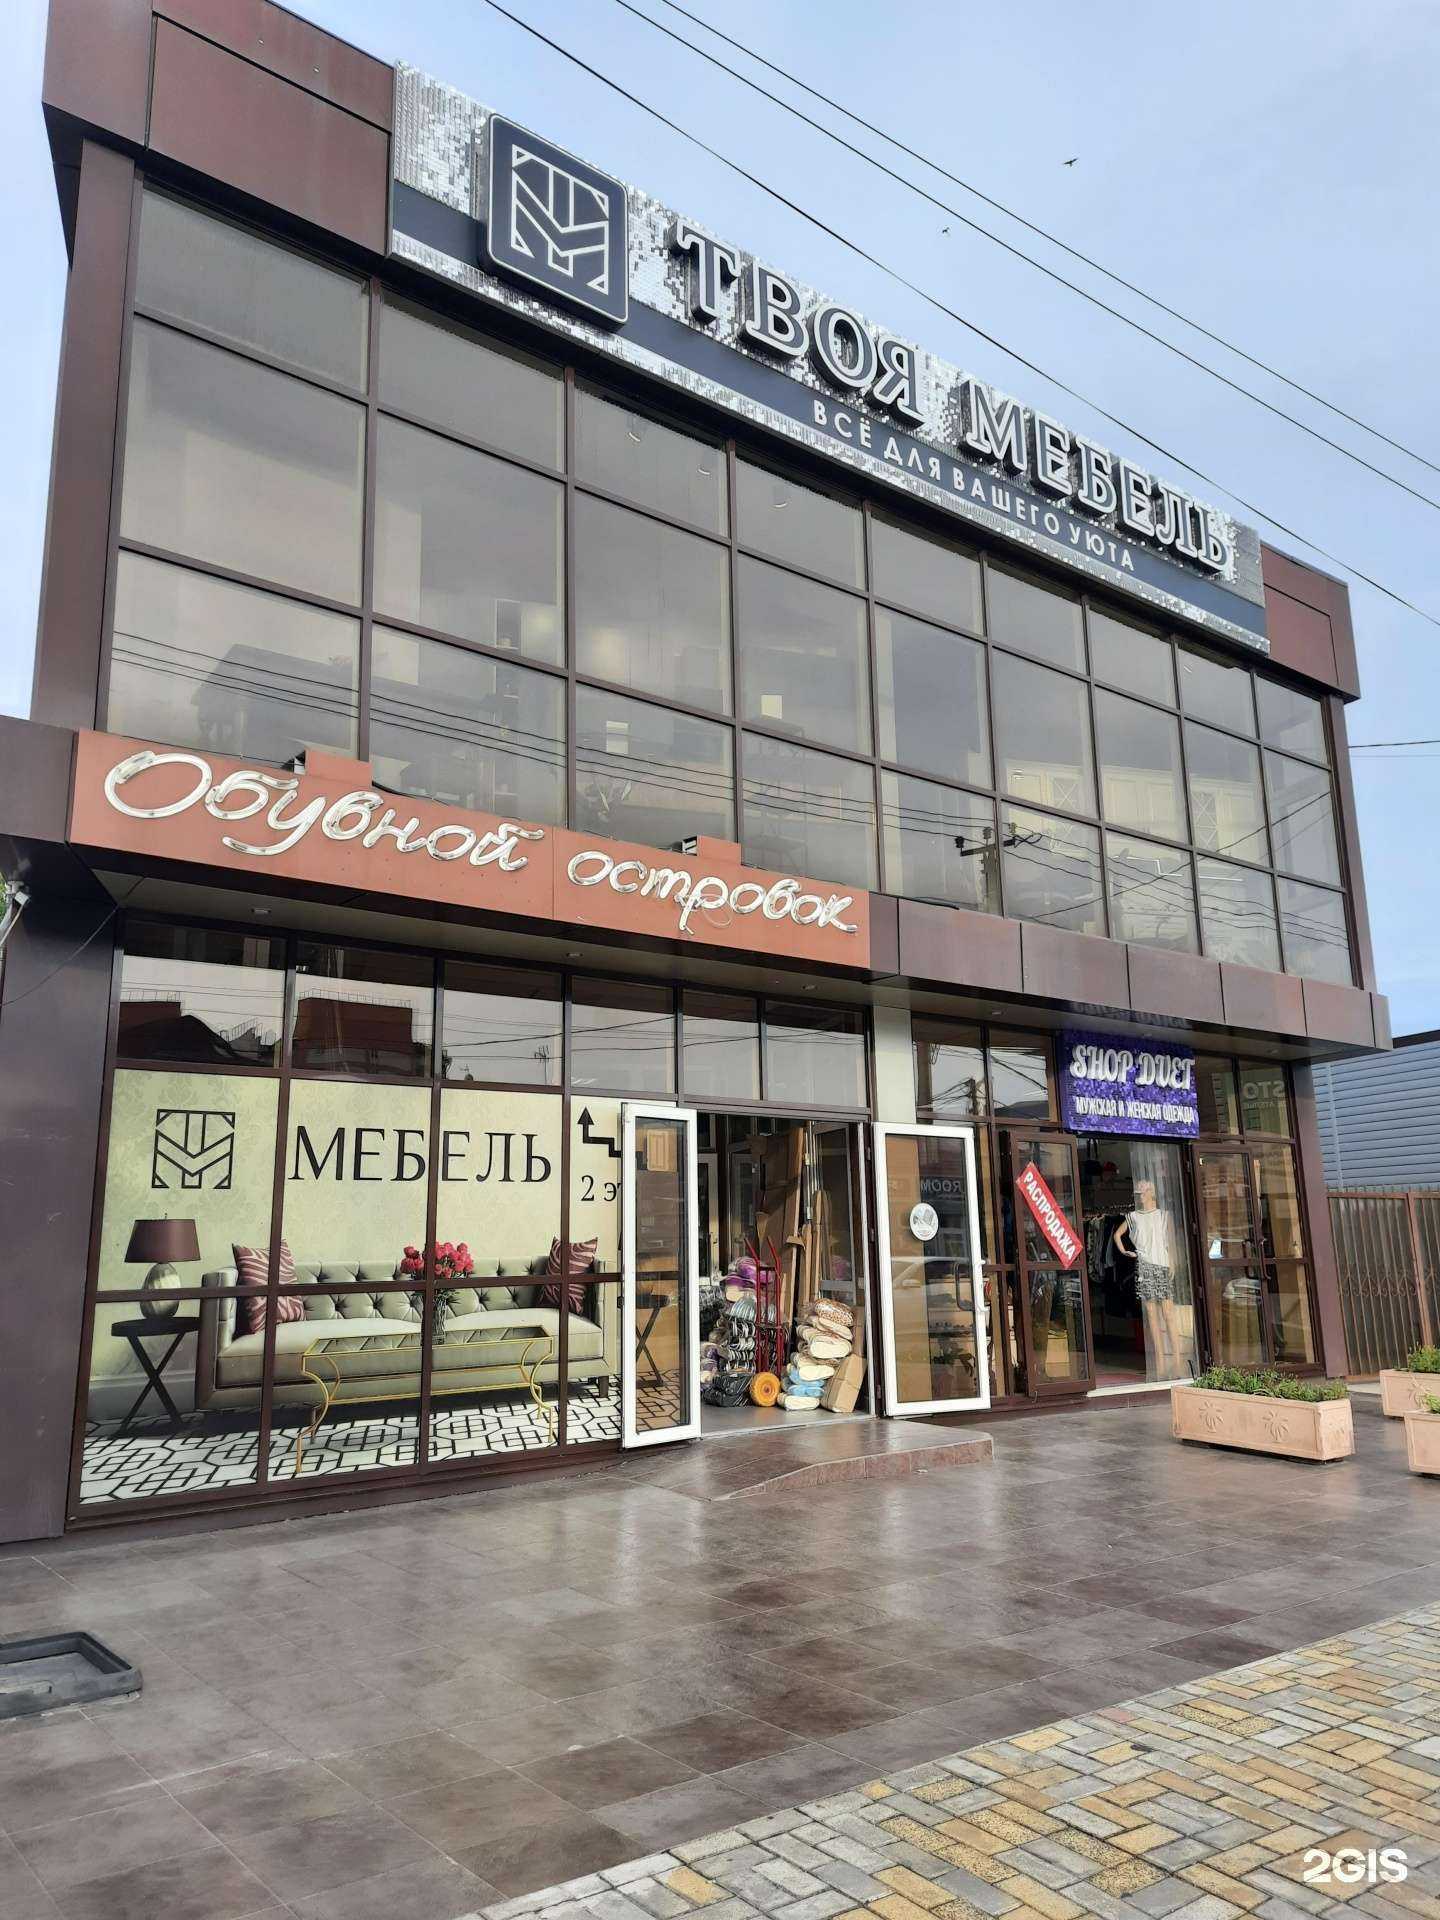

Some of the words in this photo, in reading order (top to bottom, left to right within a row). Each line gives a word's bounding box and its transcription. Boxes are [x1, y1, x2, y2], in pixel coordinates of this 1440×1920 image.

[672, 218, 927, 427] ТВОЯ
[963, 378, 1234, 574] МЕБЕЛЬ
[812, 399, 872, 449] ВСЁ
[883, 436, 942, 481] ДЛЯ
[952, 466, 1060, 535] ВАШЕГО
[1068, 521, 1135, 572] УЮТА
[104, 750, 545, 872] Обувной
[567, 850, 859, 934] островок
[1070, 1044, 1134, 1083] SHOP
[1135, 1051, 1196, 1090] DUET
[1075, 1096, 1117, 1117] МУЖСКАЯ
[1118, 1100, 1125, 1117] И
[1126, 1101, 1161, 1120] ЖЕНСКАЯ
[1162, 1104, 1196, 1126] ОДЕЖДА
[287, 1125, 552, 1183] МЕБЕЛЬ
[580, 1174, 595, 1202] 2
[1023, 1171, 1077, 1261] РАСПРОДАЖА
